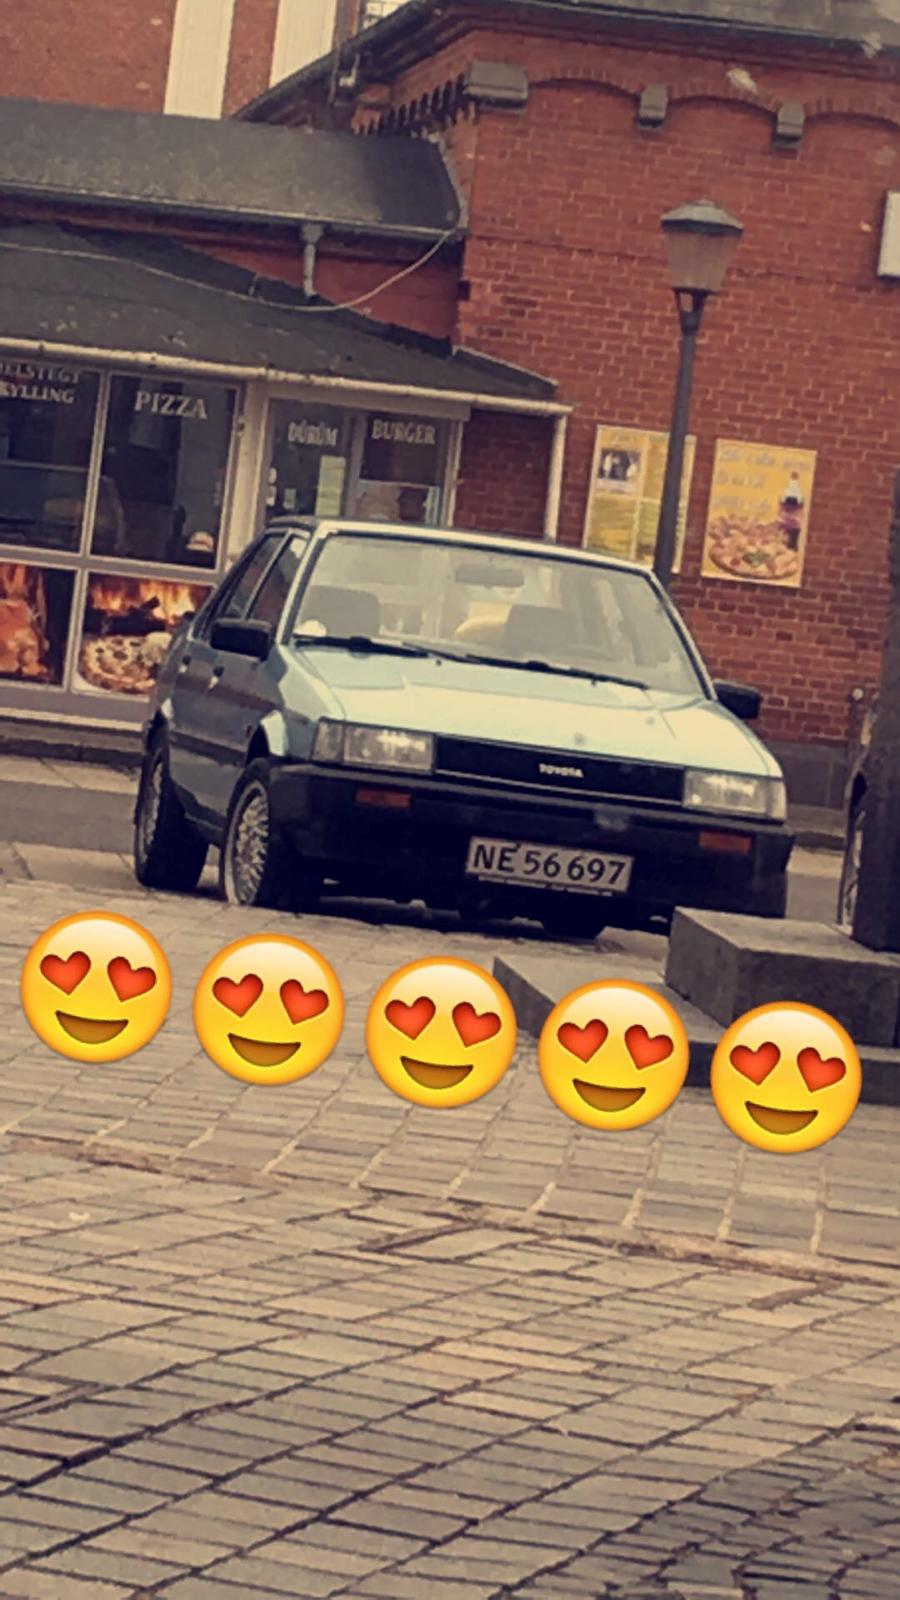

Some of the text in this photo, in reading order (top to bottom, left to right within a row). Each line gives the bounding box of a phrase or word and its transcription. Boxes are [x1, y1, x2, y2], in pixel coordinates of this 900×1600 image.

[134, 390, 208, 420] PIZZA
[371, 418, 437, 446] BURGER
[538, 763, 585, 778] TOYOTA
